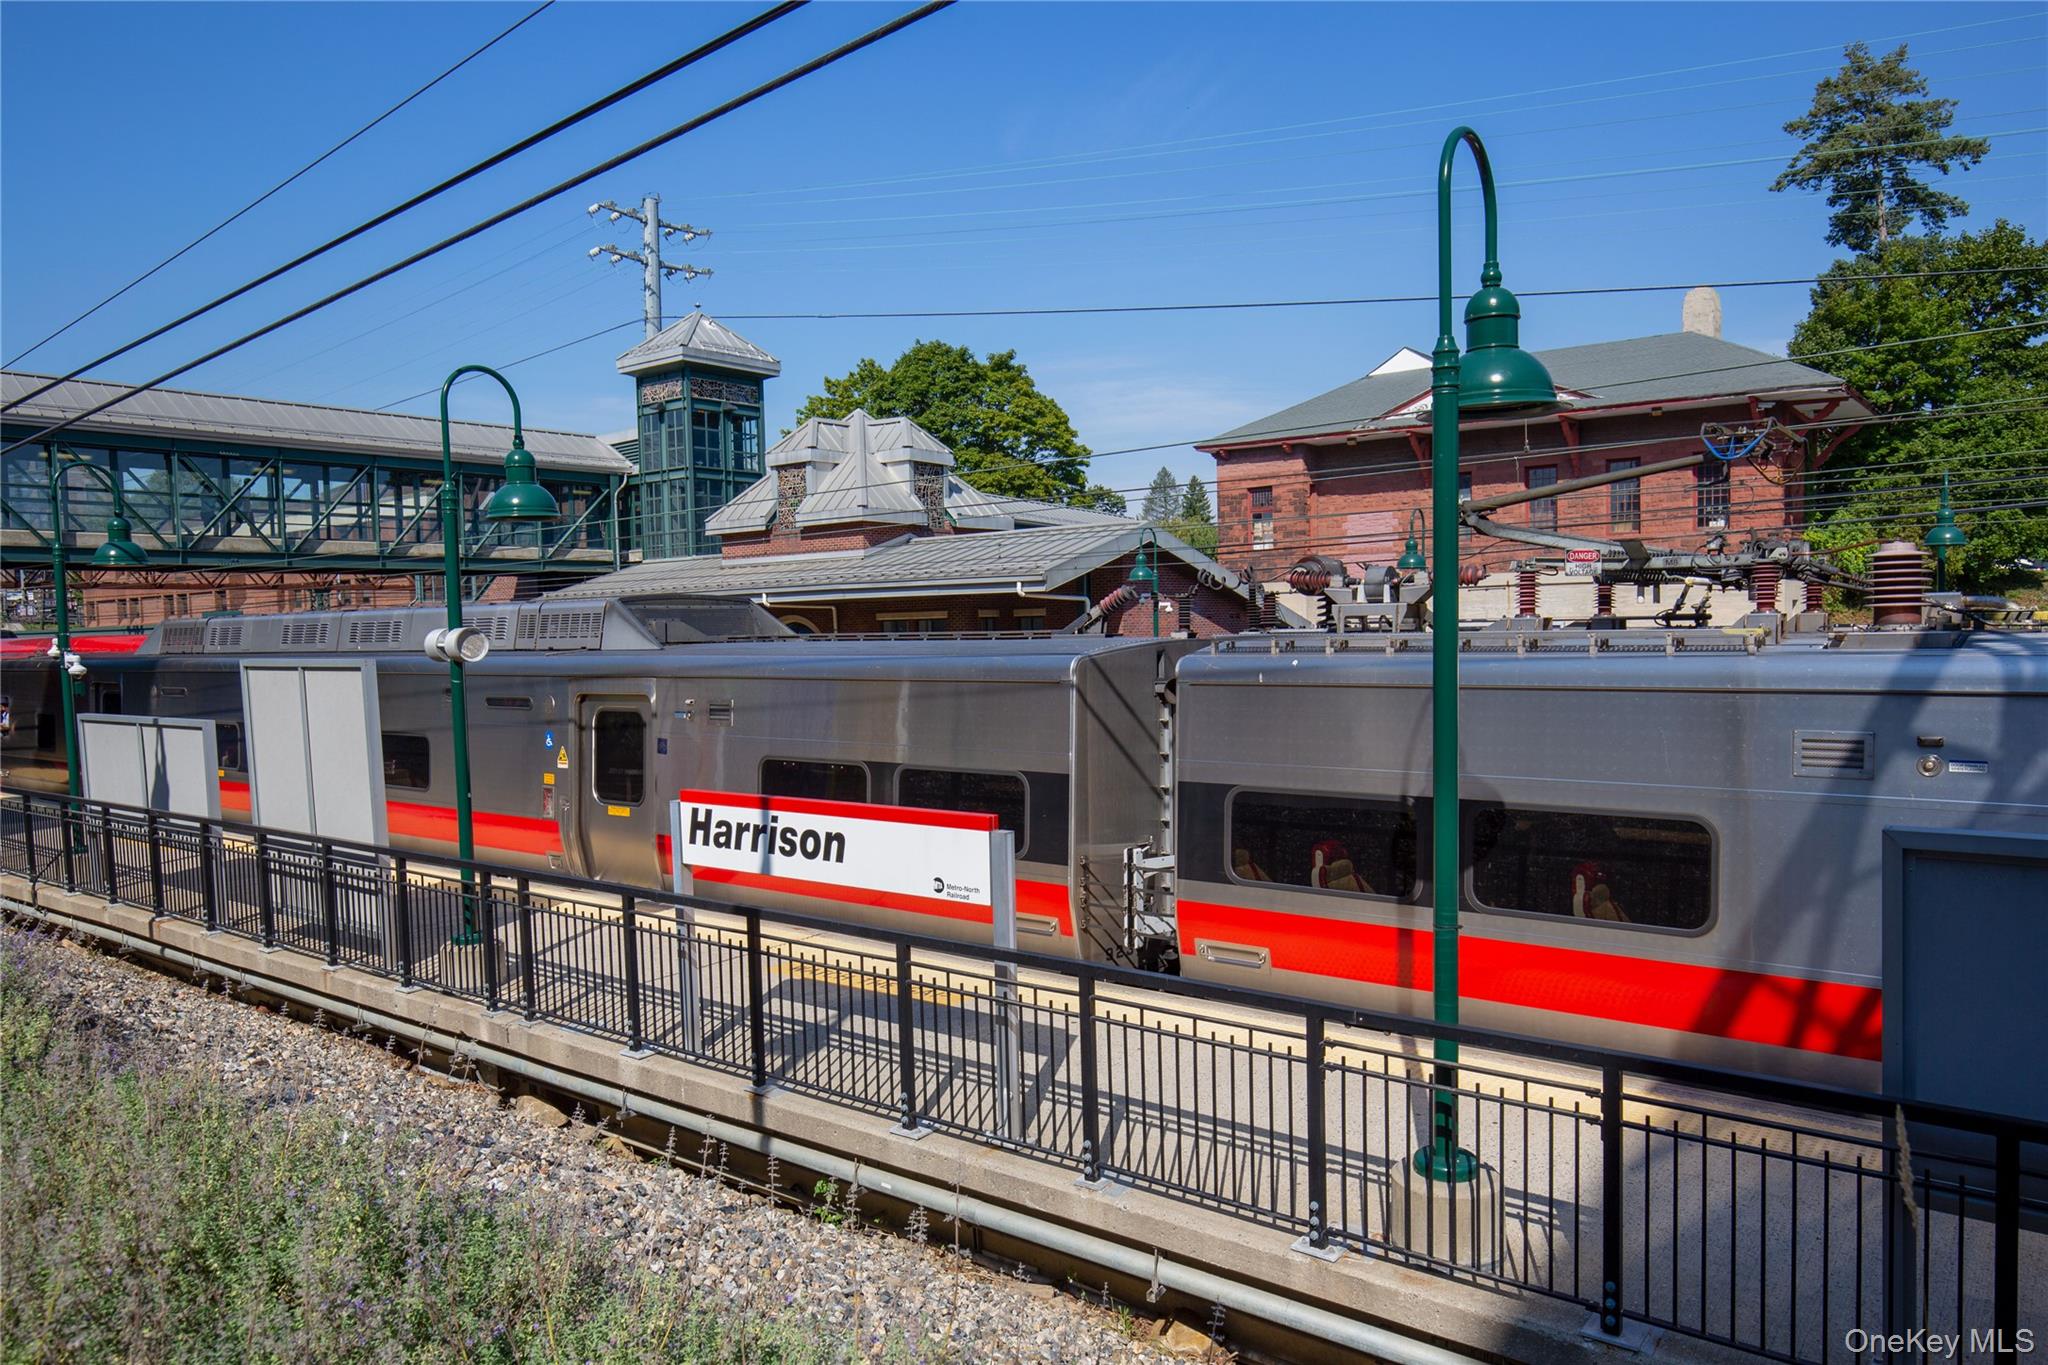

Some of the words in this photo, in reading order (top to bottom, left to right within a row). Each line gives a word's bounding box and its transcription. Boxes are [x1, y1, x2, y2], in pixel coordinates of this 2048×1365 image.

[1569, 552, 1598, 560] DANGER
[1569, 568, 1599, 576] VOLTAGE
[688, 807, 846, 863] Harrison
[946, 883, 981, 894] Metro-North
[946, 891, 970, 900] Railroad
